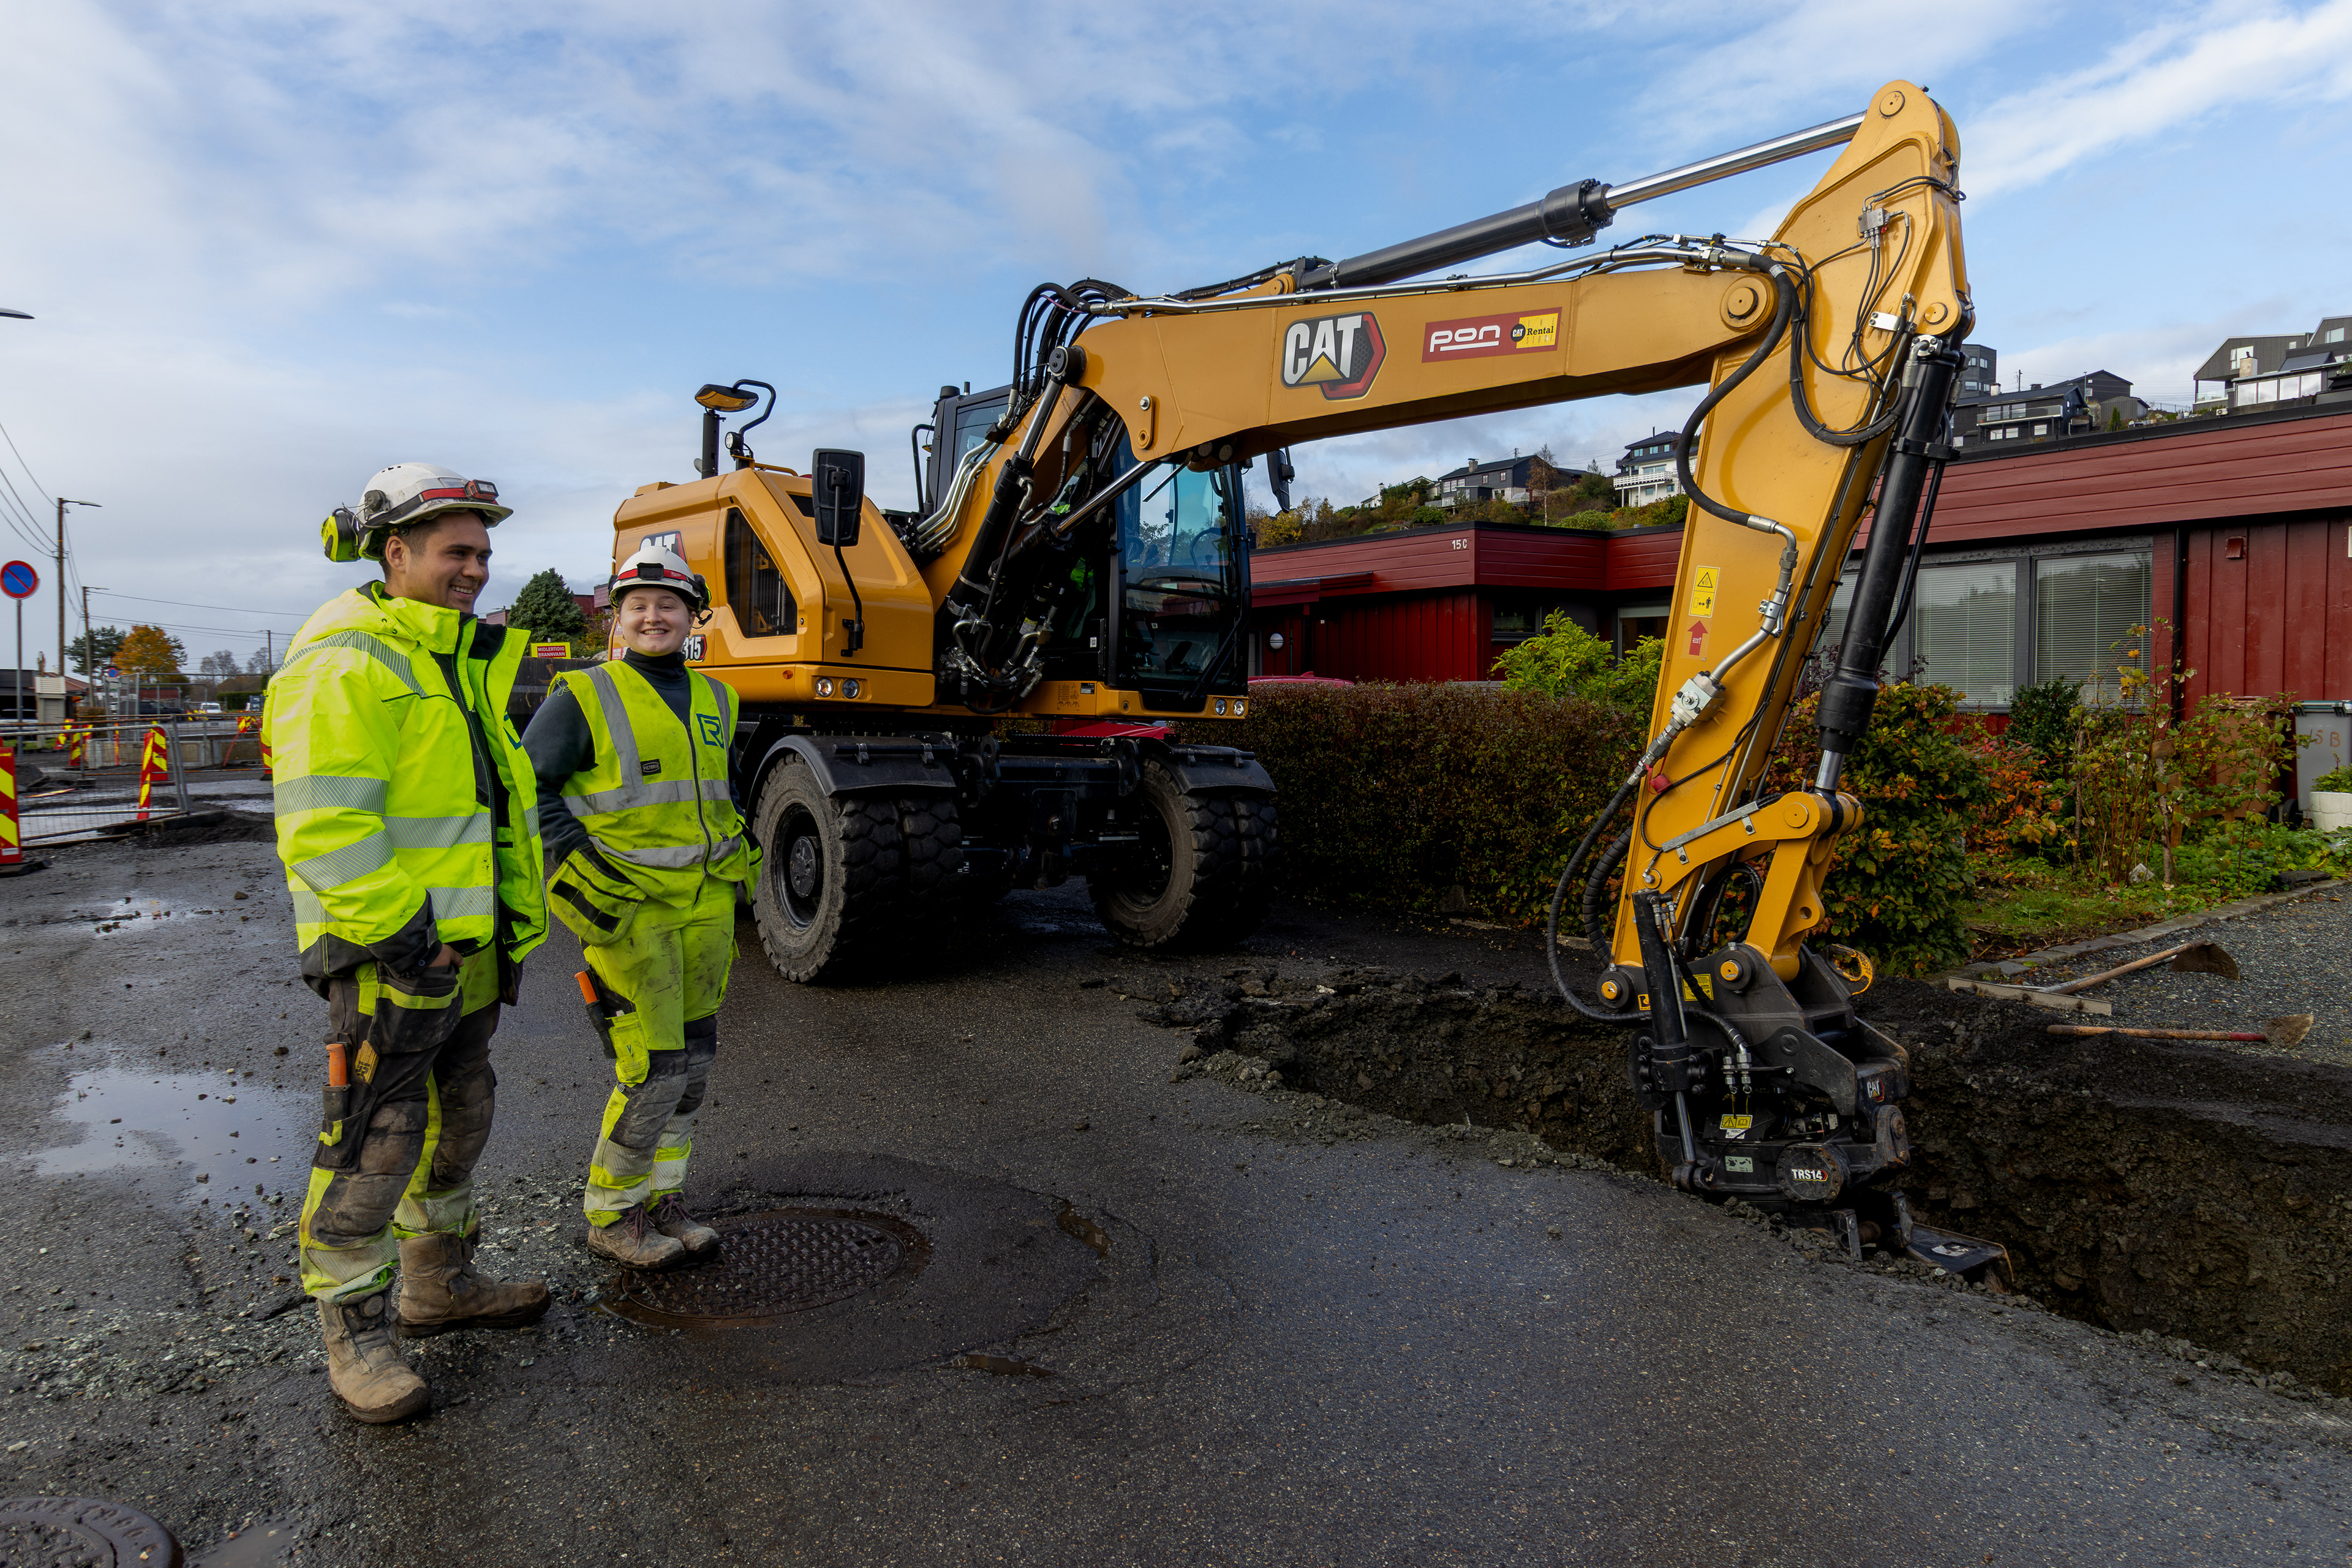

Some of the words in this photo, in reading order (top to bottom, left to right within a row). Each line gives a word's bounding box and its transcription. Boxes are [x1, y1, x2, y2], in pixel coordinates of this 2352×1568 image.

[1512, 328, 1524, 337] CAT
[1526, 325, 1554, 336] Rental
[1429, 325, 1501, 353] pon
[1284, 315, 1362, 385] CAT
[2330, 731, 2341, 747] B
[1867, 1079, 1880, 1098] CAT
[1791, 1169, 1823, 1180] TRS14
